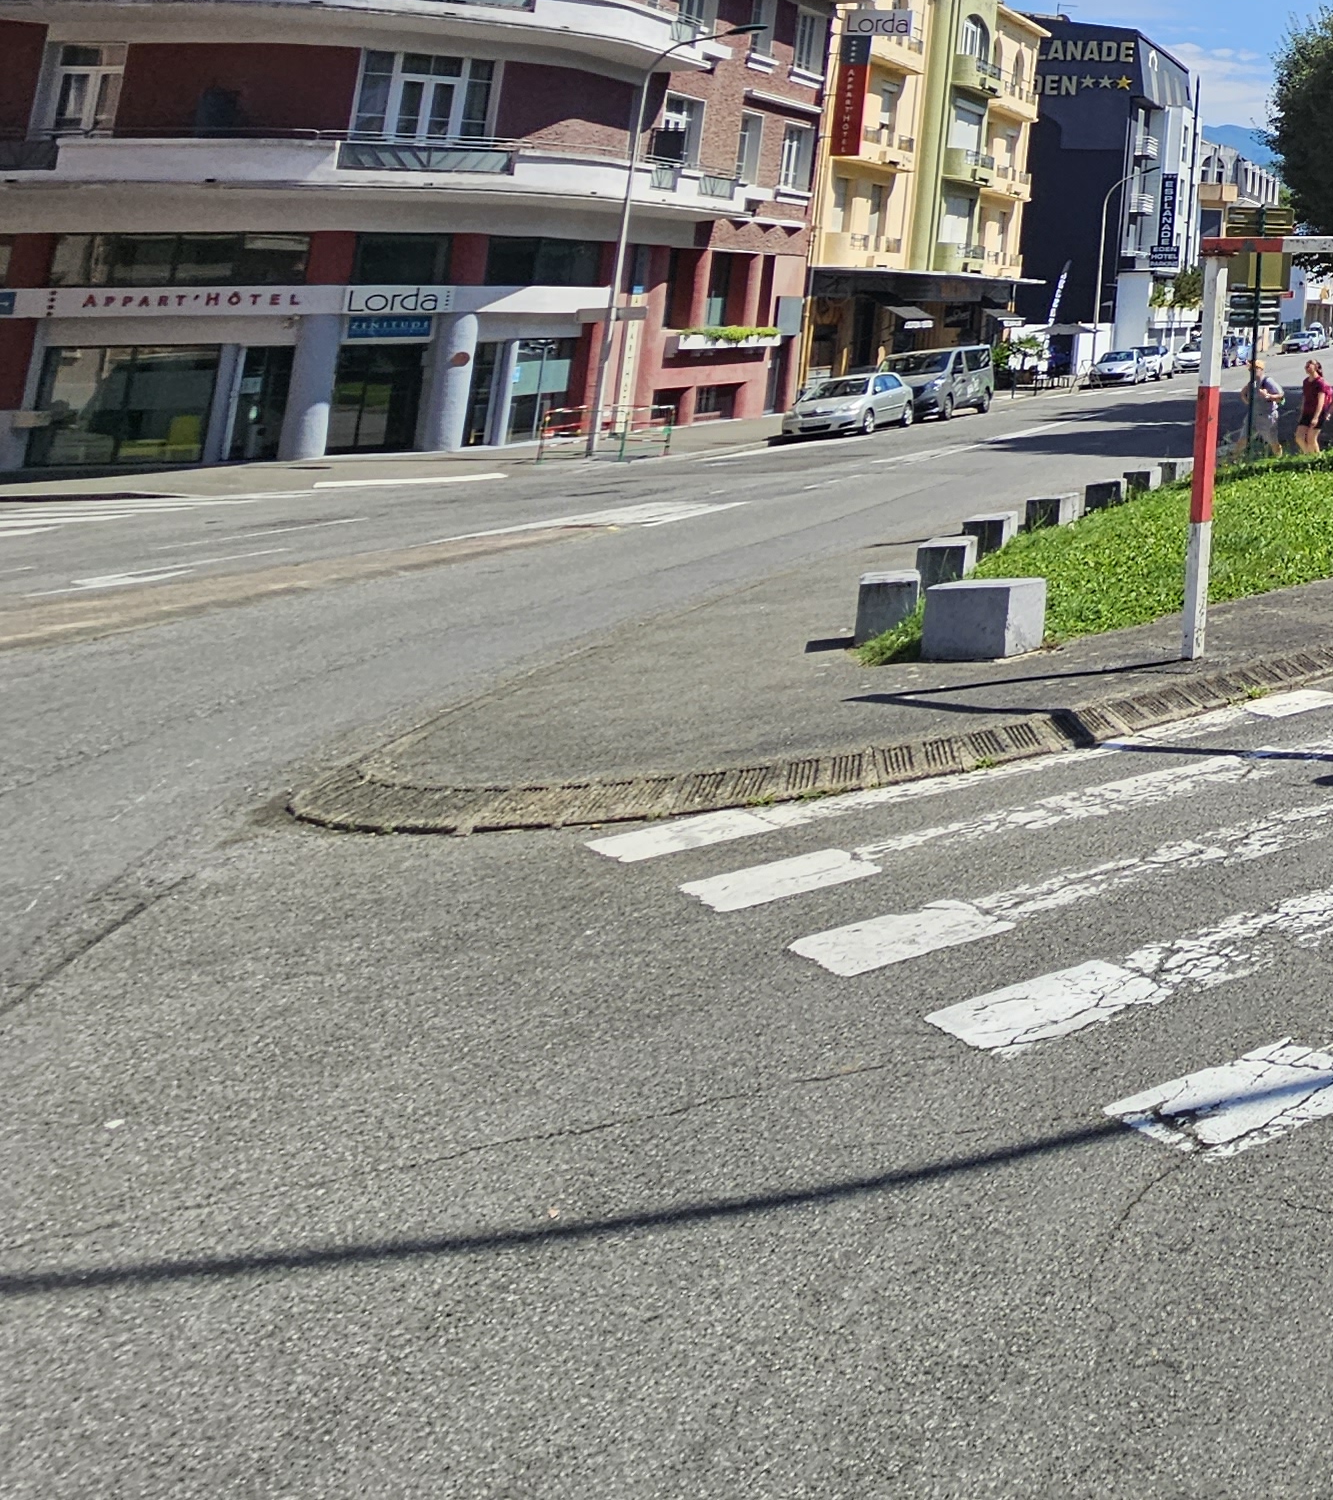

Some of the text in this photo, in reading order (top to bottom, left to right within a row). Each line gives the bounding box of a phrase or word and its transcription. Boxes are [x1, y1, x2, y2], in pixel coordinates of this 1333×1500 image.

[846, 12, 909, 34] Lorda
[1161, 181, 1174, 245] ESPLANADE
[348, 287, 438, 312] Lorda
